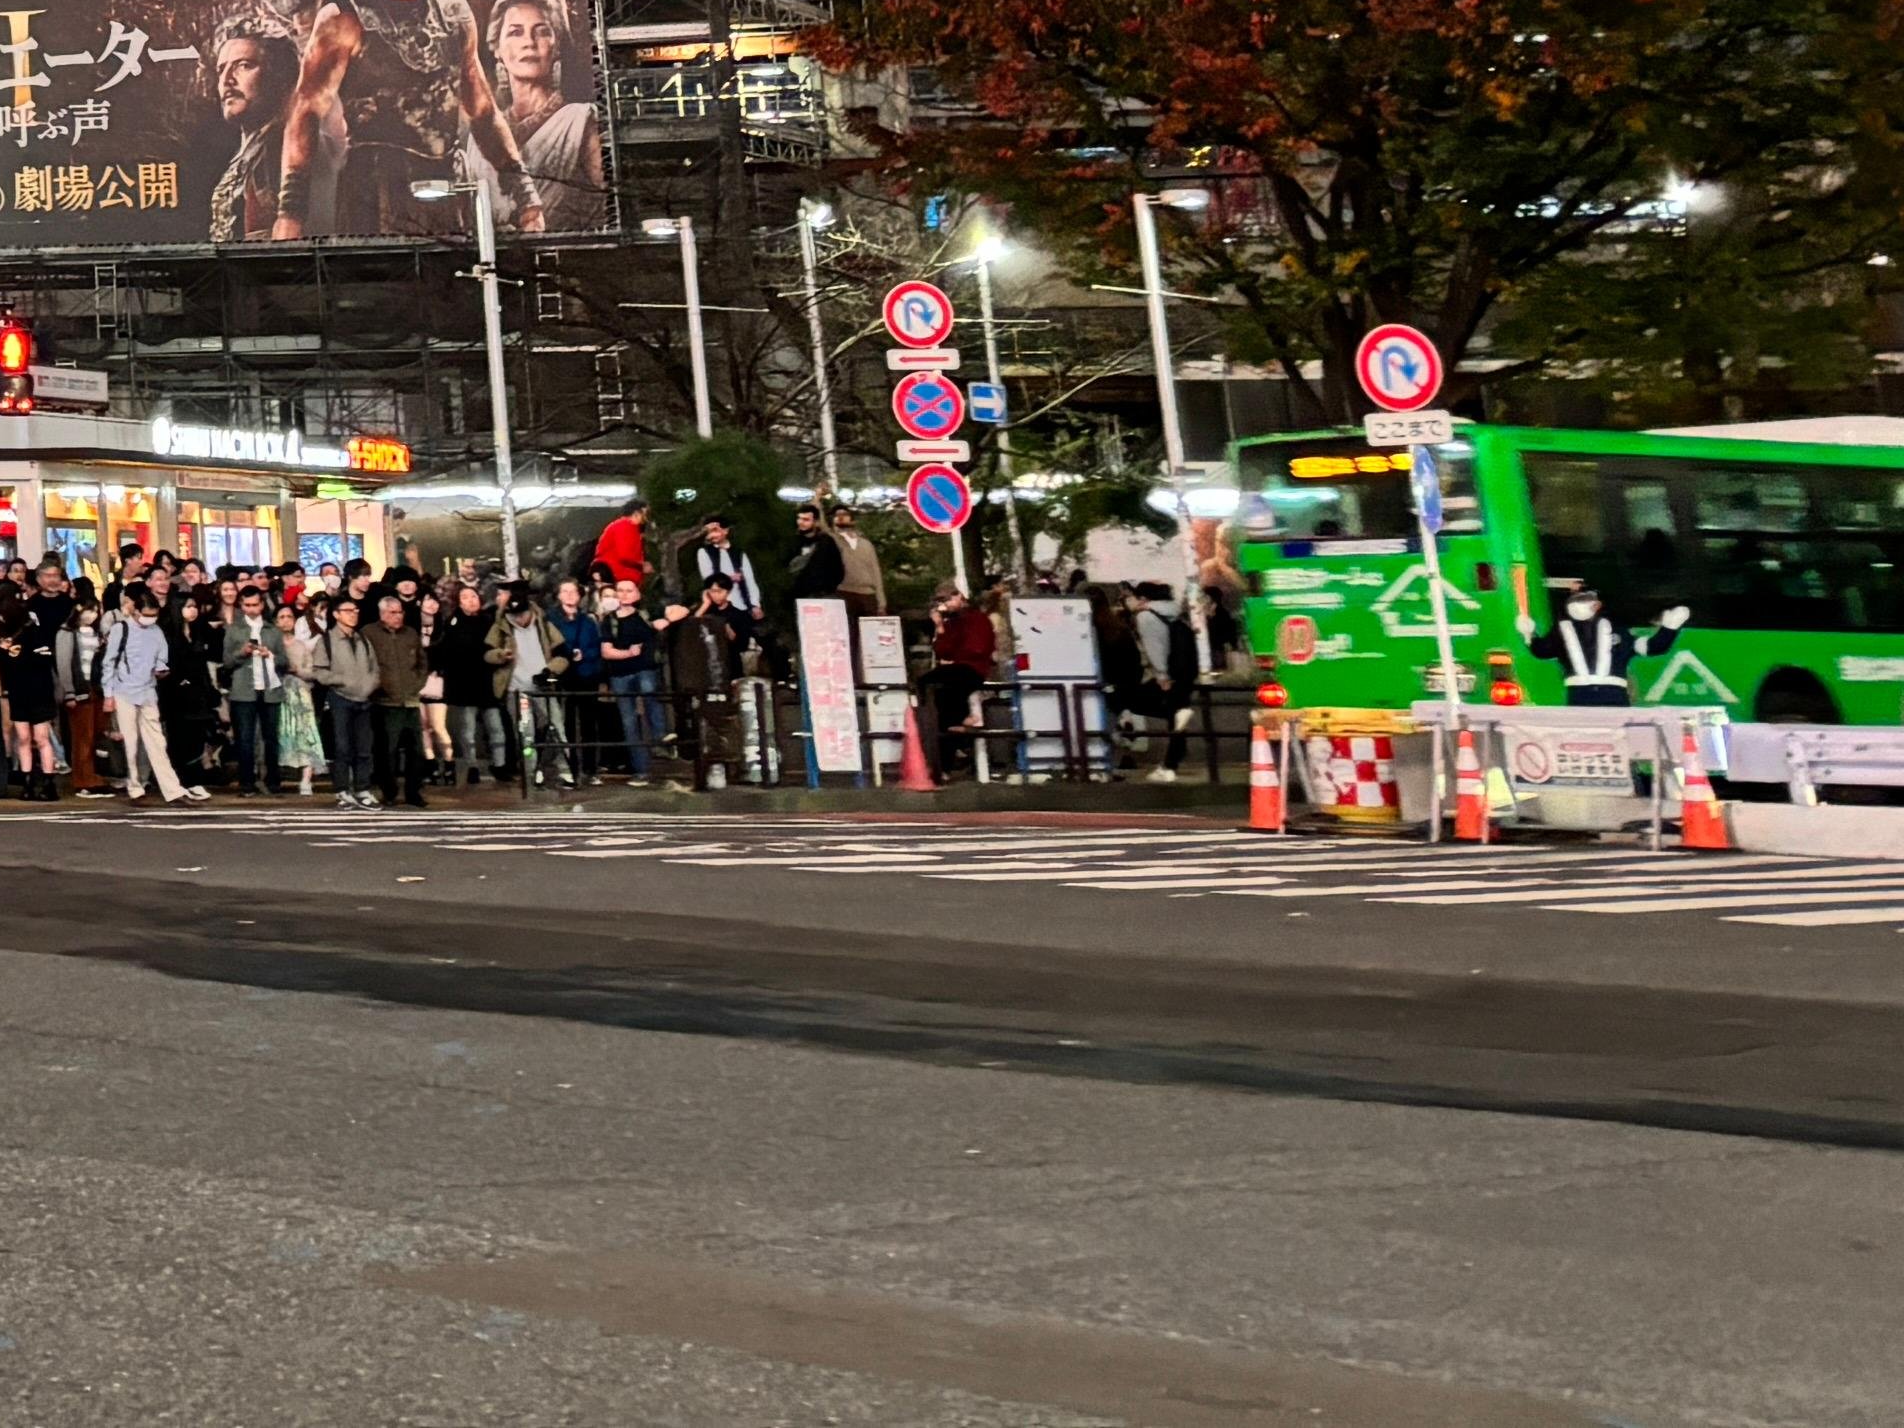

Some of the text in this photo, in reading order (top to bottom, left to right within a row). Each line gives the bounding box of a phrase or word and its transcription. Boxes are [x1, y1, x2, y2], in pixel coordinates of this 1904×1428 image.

[13, 161, 180, 213] 劇場公開
[1375, 420, 1443, 439] ここまで
